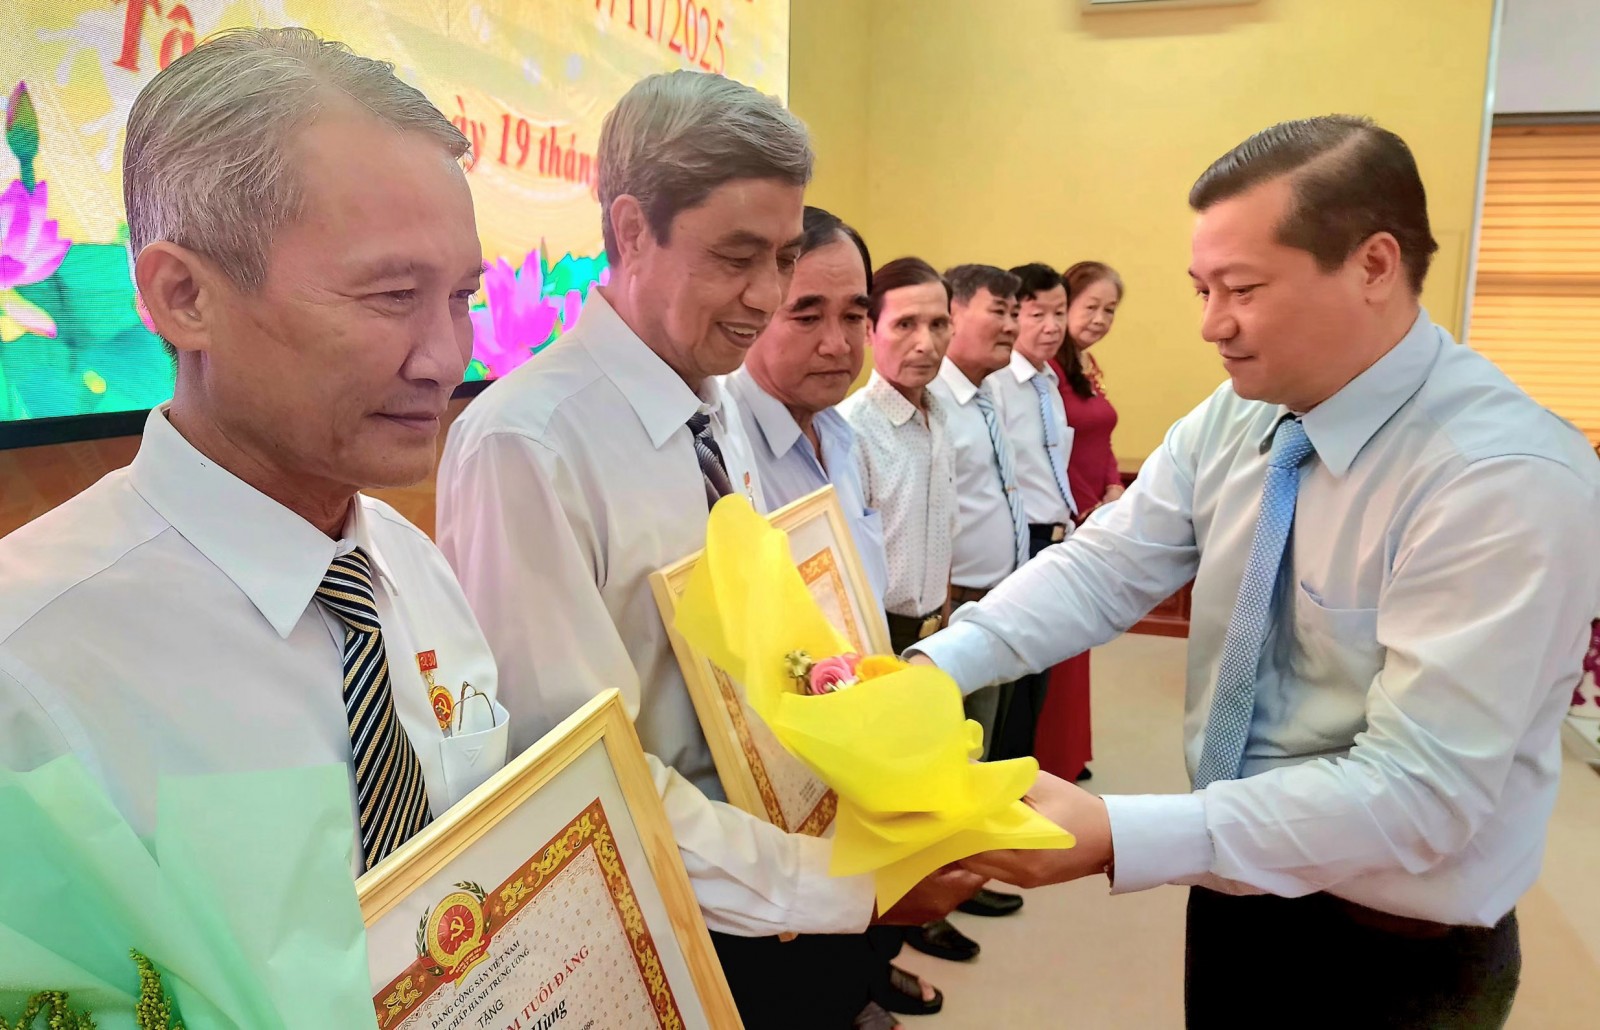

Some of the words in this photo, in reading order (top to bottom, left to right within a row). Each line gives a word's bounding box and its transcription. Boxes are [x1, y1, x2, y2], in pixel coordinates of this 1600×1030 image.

[112, 0, 202, 73] Tâ
[498, 113, 531, 170] 19
[431, 1005, 454, 1030] ĐẢNG
[454, 985, 475, 1008] CỘNG
[474, 971, 490, 988] SẢN
[488, 956, 506, 973] VIỆT
[504, 940, 521, 959] NAM
[468, 989, 489, 1012] HÀNH
[488, 965, 512, 991] TRUNG
[511, 948, 530, 969] ƯƠNG
[476, 999, 504, 1029] TẶNG
[521, 981, 554, 1021] TUỔI
[553, 945, 589, 988] ĐẢNG
